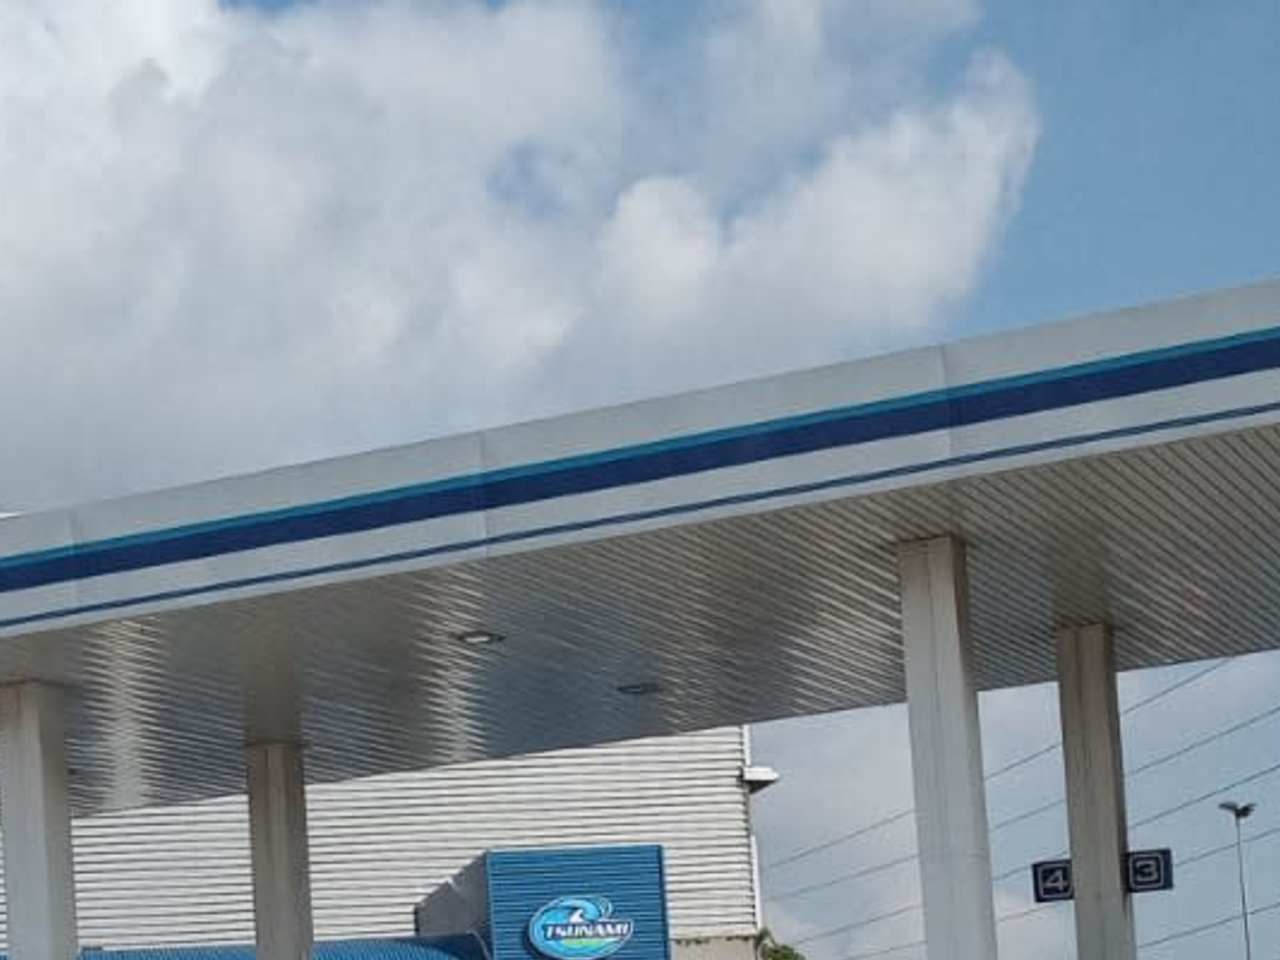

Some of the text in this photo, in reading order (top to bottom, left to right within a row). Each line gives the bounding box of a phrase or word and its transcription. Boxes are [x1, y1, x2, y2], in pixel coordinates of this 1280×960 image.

[1044, 868, 1069, 892] 4
[1135, 859, 1159, 882] 3
[546, 922, 629, 939] TSUNAMI
